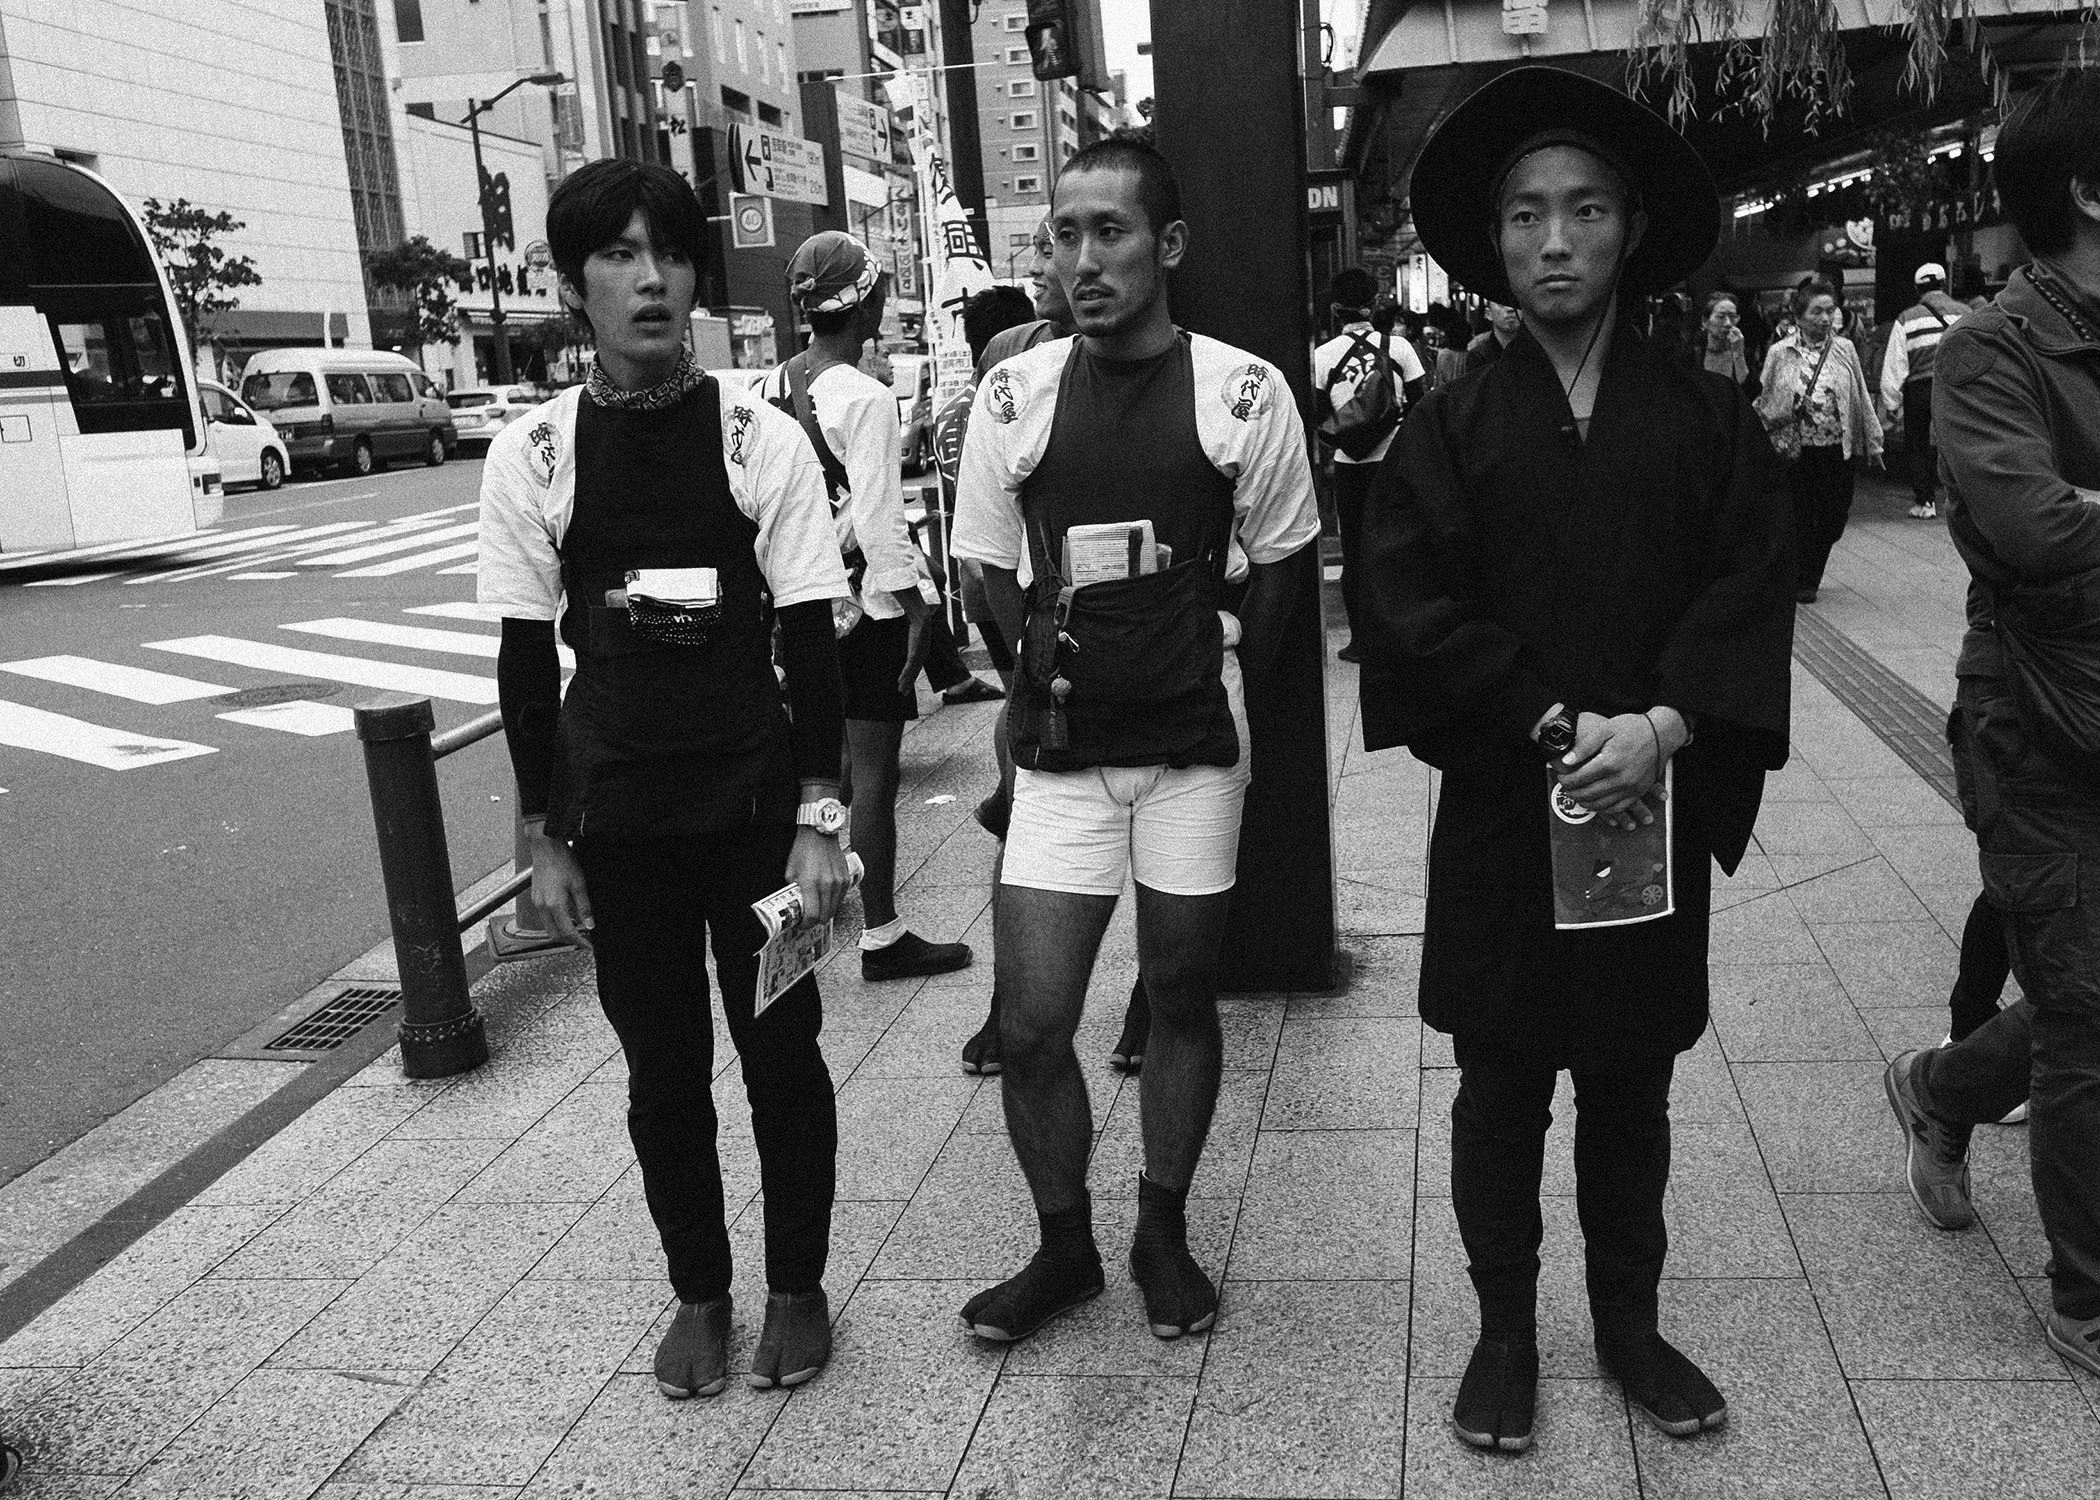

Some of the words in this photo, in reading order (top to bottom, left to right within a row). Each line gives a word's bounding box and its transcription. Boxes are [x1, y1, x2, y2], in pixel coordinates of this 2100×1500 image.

[990, 368, 1018, 424] 時代屋
[1231, 364, 1269, 422] 時代屋
